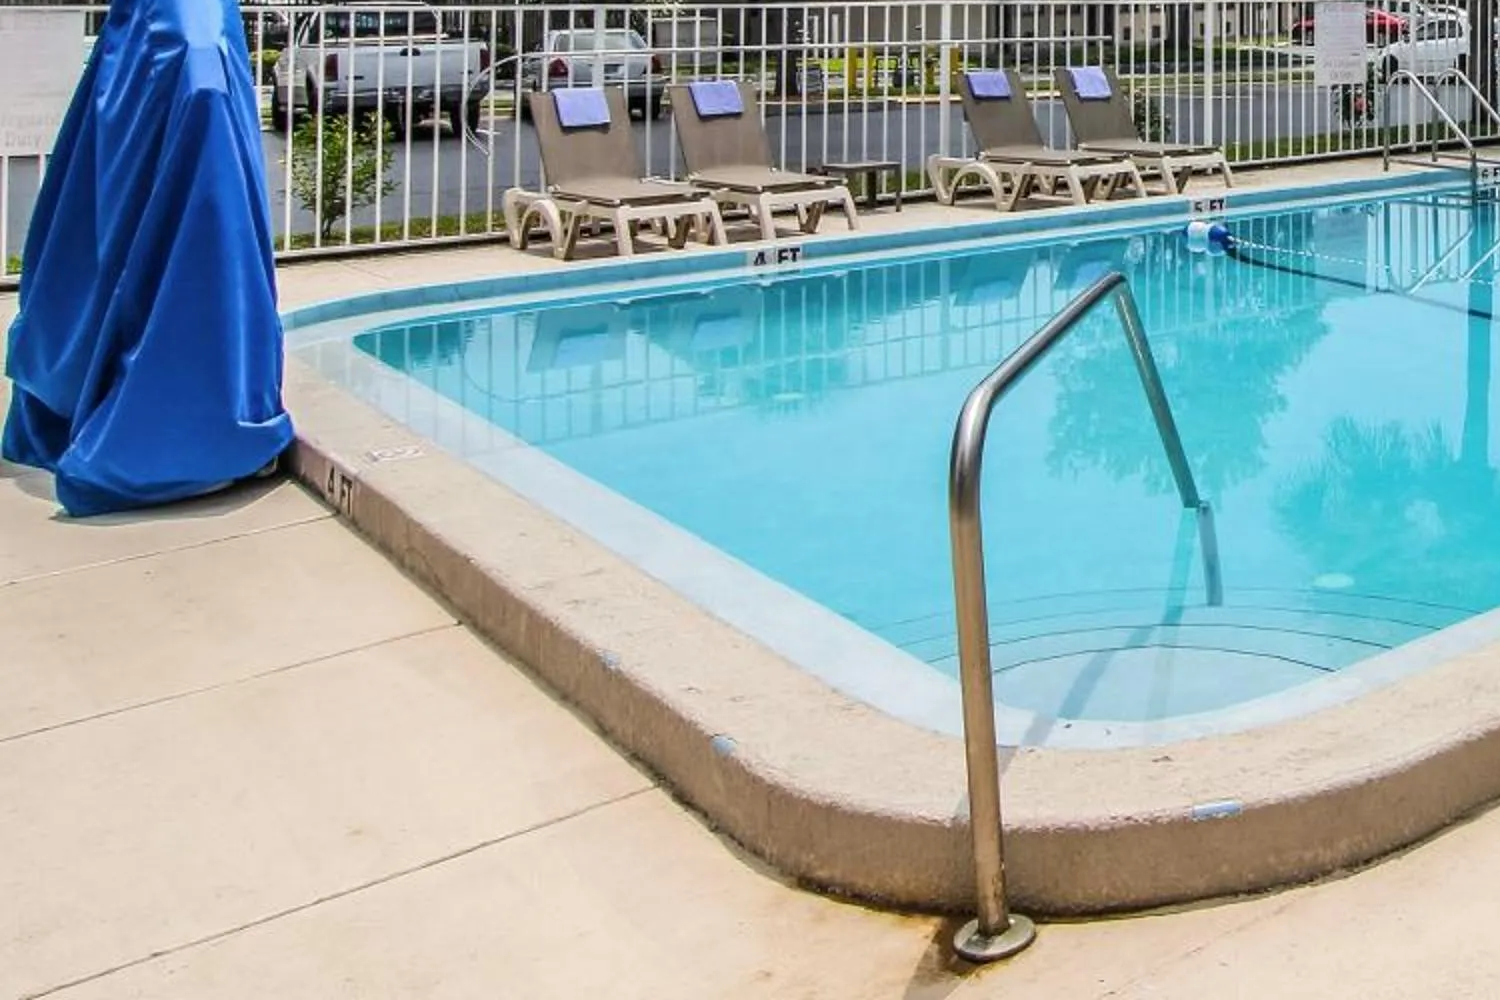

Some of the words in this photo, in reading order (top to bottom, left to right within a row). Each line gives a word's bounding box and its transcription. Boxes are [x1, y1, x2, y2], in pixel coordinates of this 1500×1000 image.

[1209, 198, 1224, 212] FT
[777, 247, 801, 264] FT
[341, 474, 353, 515] FT
